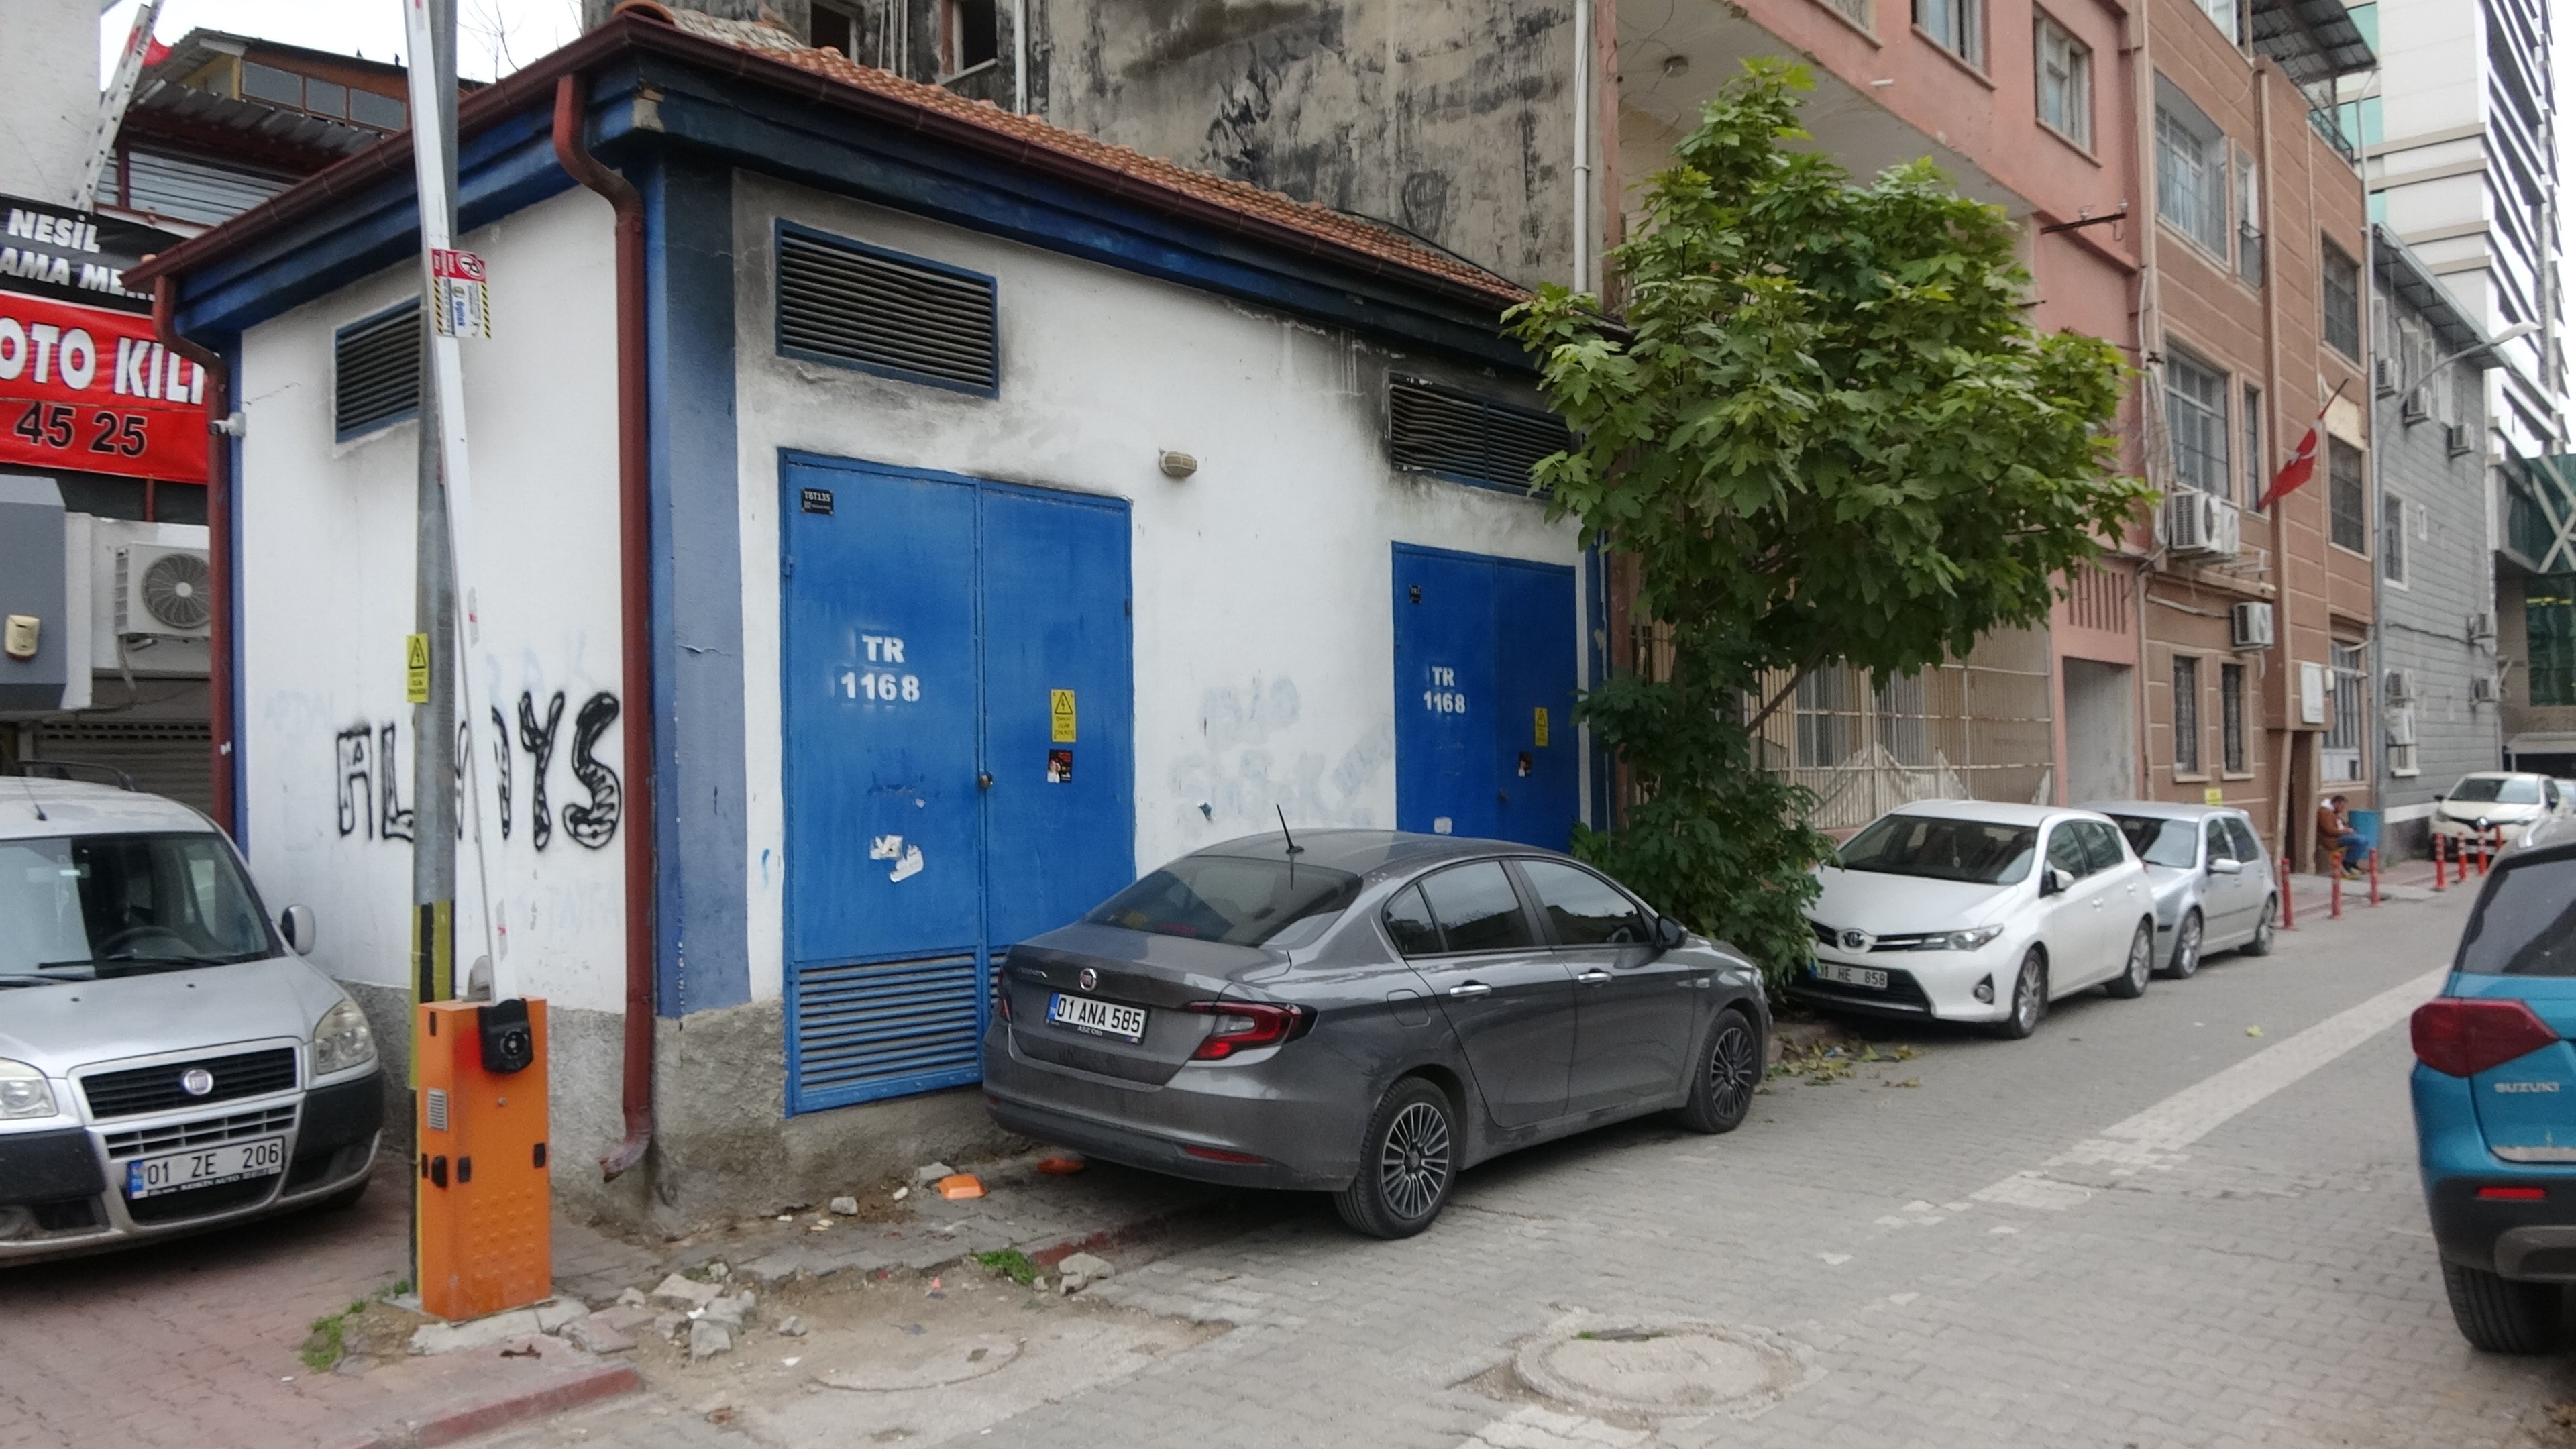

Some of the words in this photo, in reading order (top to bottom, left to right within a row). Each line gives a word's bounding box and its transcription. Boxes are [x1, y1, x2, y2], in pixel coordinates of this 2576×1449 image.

[8, 208, 100, 253] NESİL
[0, 317, 96, 390] OTO
[14, 402, 76, 449] 45
[89, 411, 147, 458] 25
[862, 635, 904, 663] TR
[841, 672, 920, 702] 1168
[1432, 665, 1455, 686] TR
[1424, 690, 1465, 714] 1168
[1838, 967, 1851, 981] HE
[1865, 971, 1886, 986] 858
[1057, 998, 1075, 1020] 01
[1078, 1002, 1106, 1026] ANA
[1110, 1008, 1141, 1033] 585
[2494, 1081, 2559, 1093] SUZUKI
[148, 1161, 169, 1185] 01
[191, 1152, 217, 1179] ZE
[242, 1143, 278, 1169] 206
